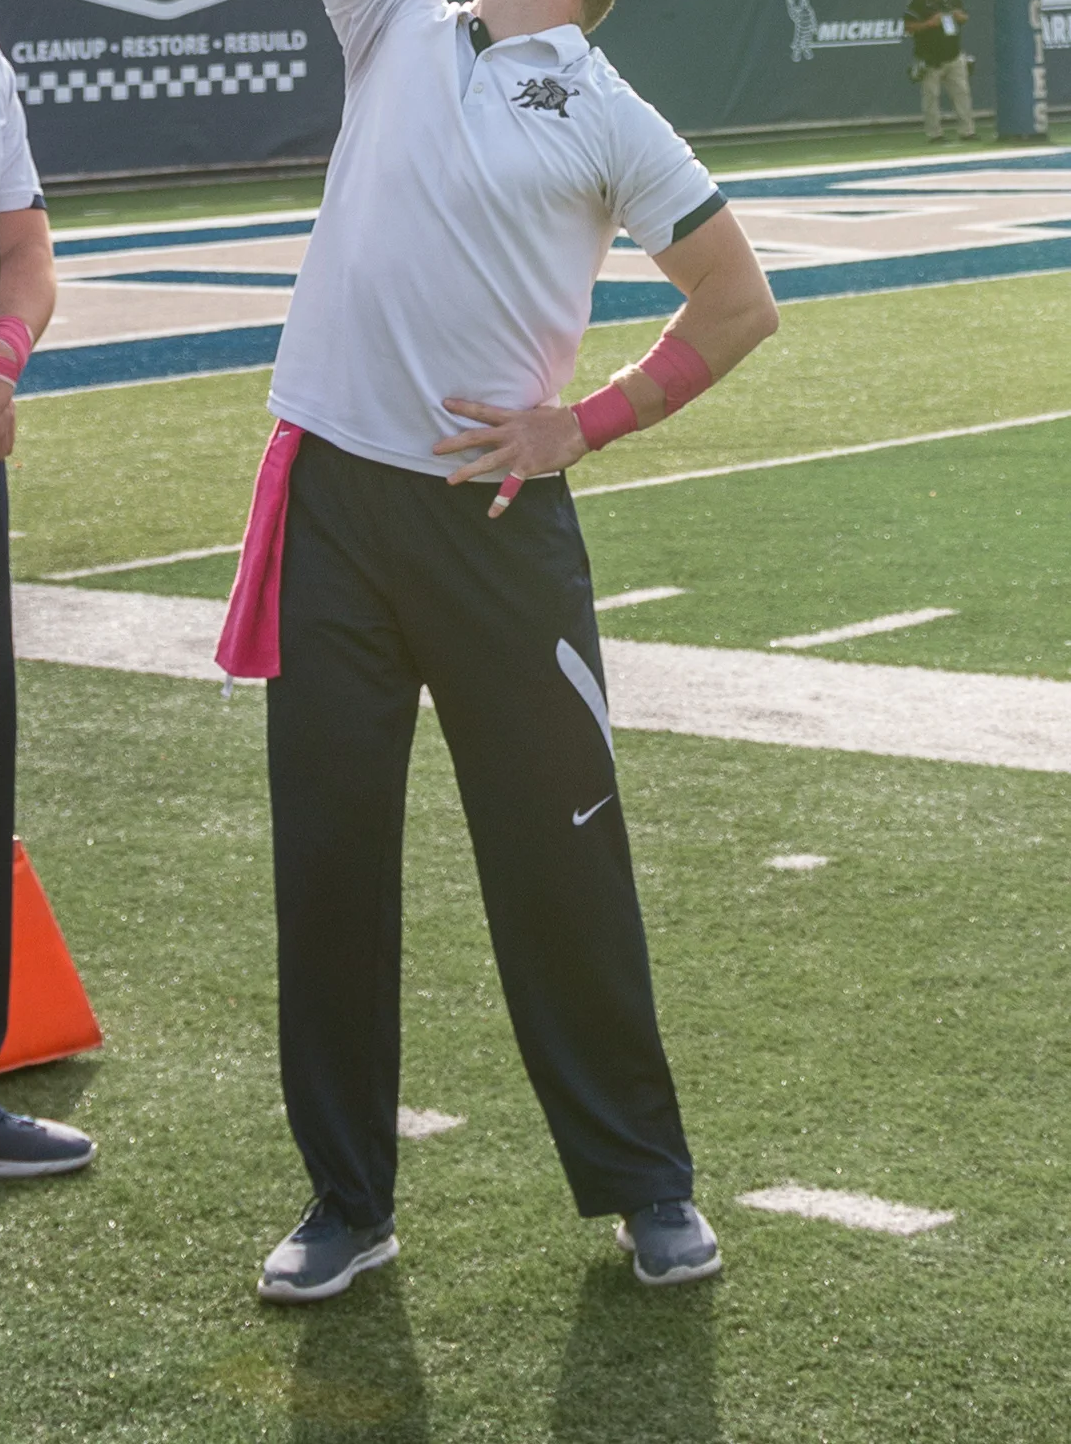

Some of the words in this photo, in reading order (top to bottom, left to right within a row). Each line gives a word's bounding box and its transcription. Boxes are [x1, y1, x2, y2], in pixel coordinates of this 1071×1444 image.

[818, 19, 913, 41] MICHELI
[12, 39, 107, 65] CLEANUP
[122, 35, 210, 58] RESTORE
[225, 30, 307, 54] REBUILD
